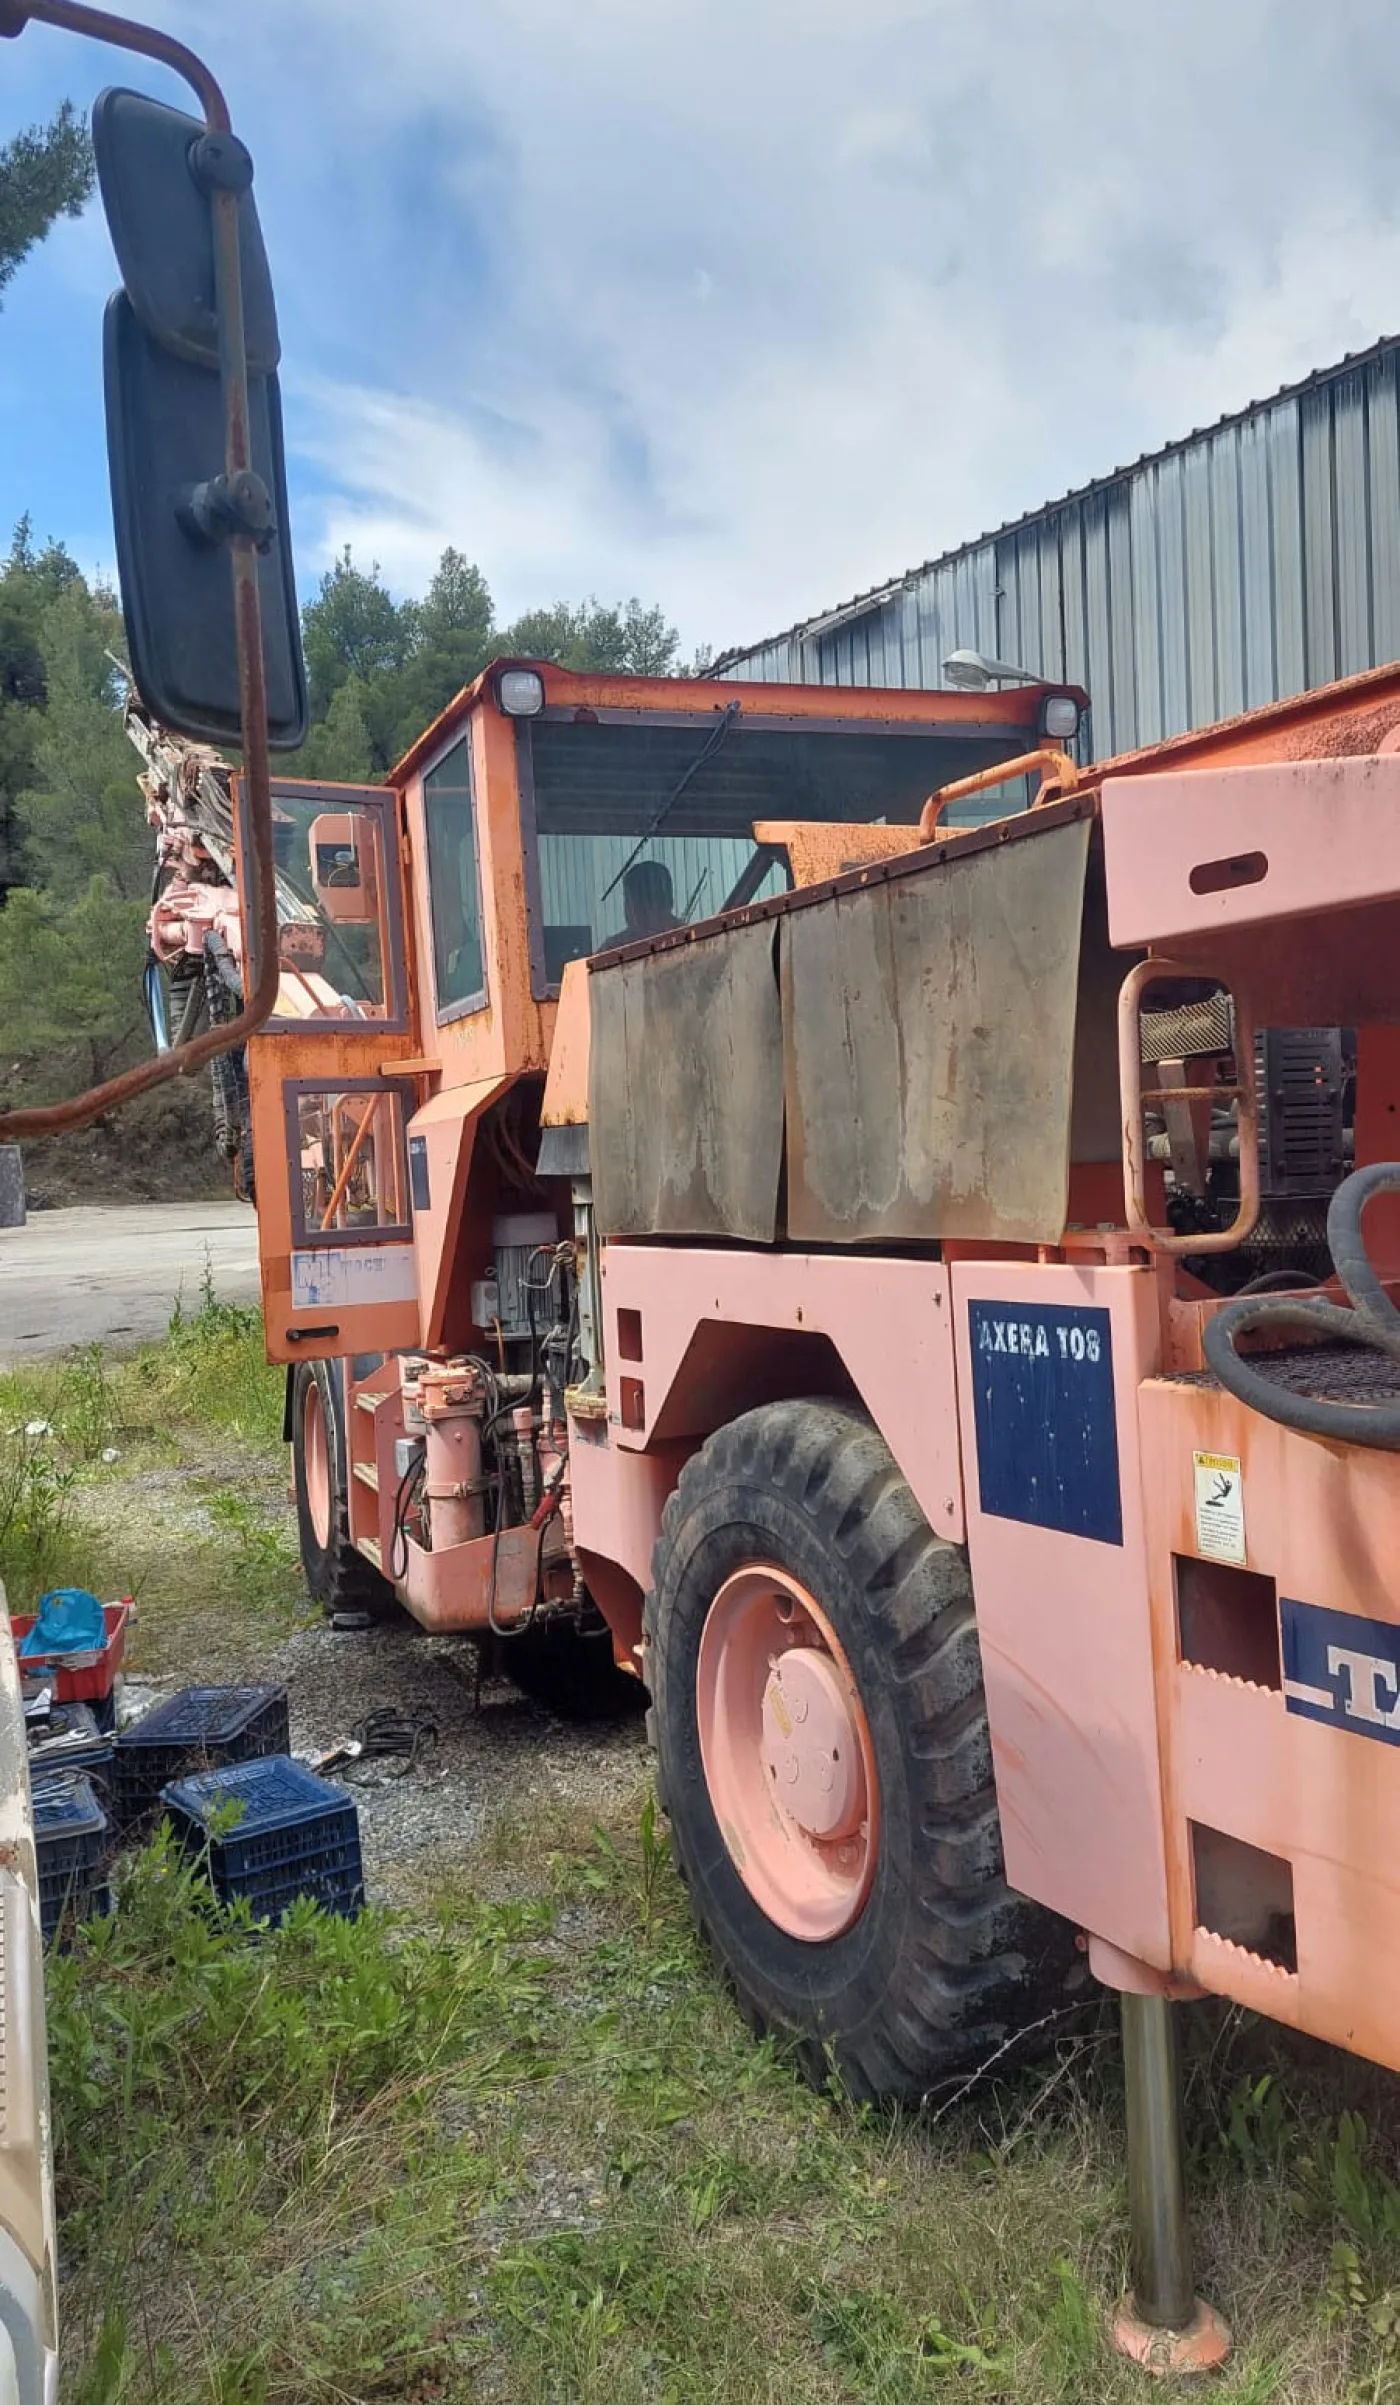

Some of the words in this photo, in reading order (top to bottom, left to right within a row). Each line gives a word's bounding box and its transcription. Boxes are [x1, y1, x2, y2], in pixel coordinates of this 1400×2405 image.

[978, 1320, 1050, 1358] AXERA
[1056, 1326, 1101, 1363] T08
[1327, 1644, 1400, 1731] T
